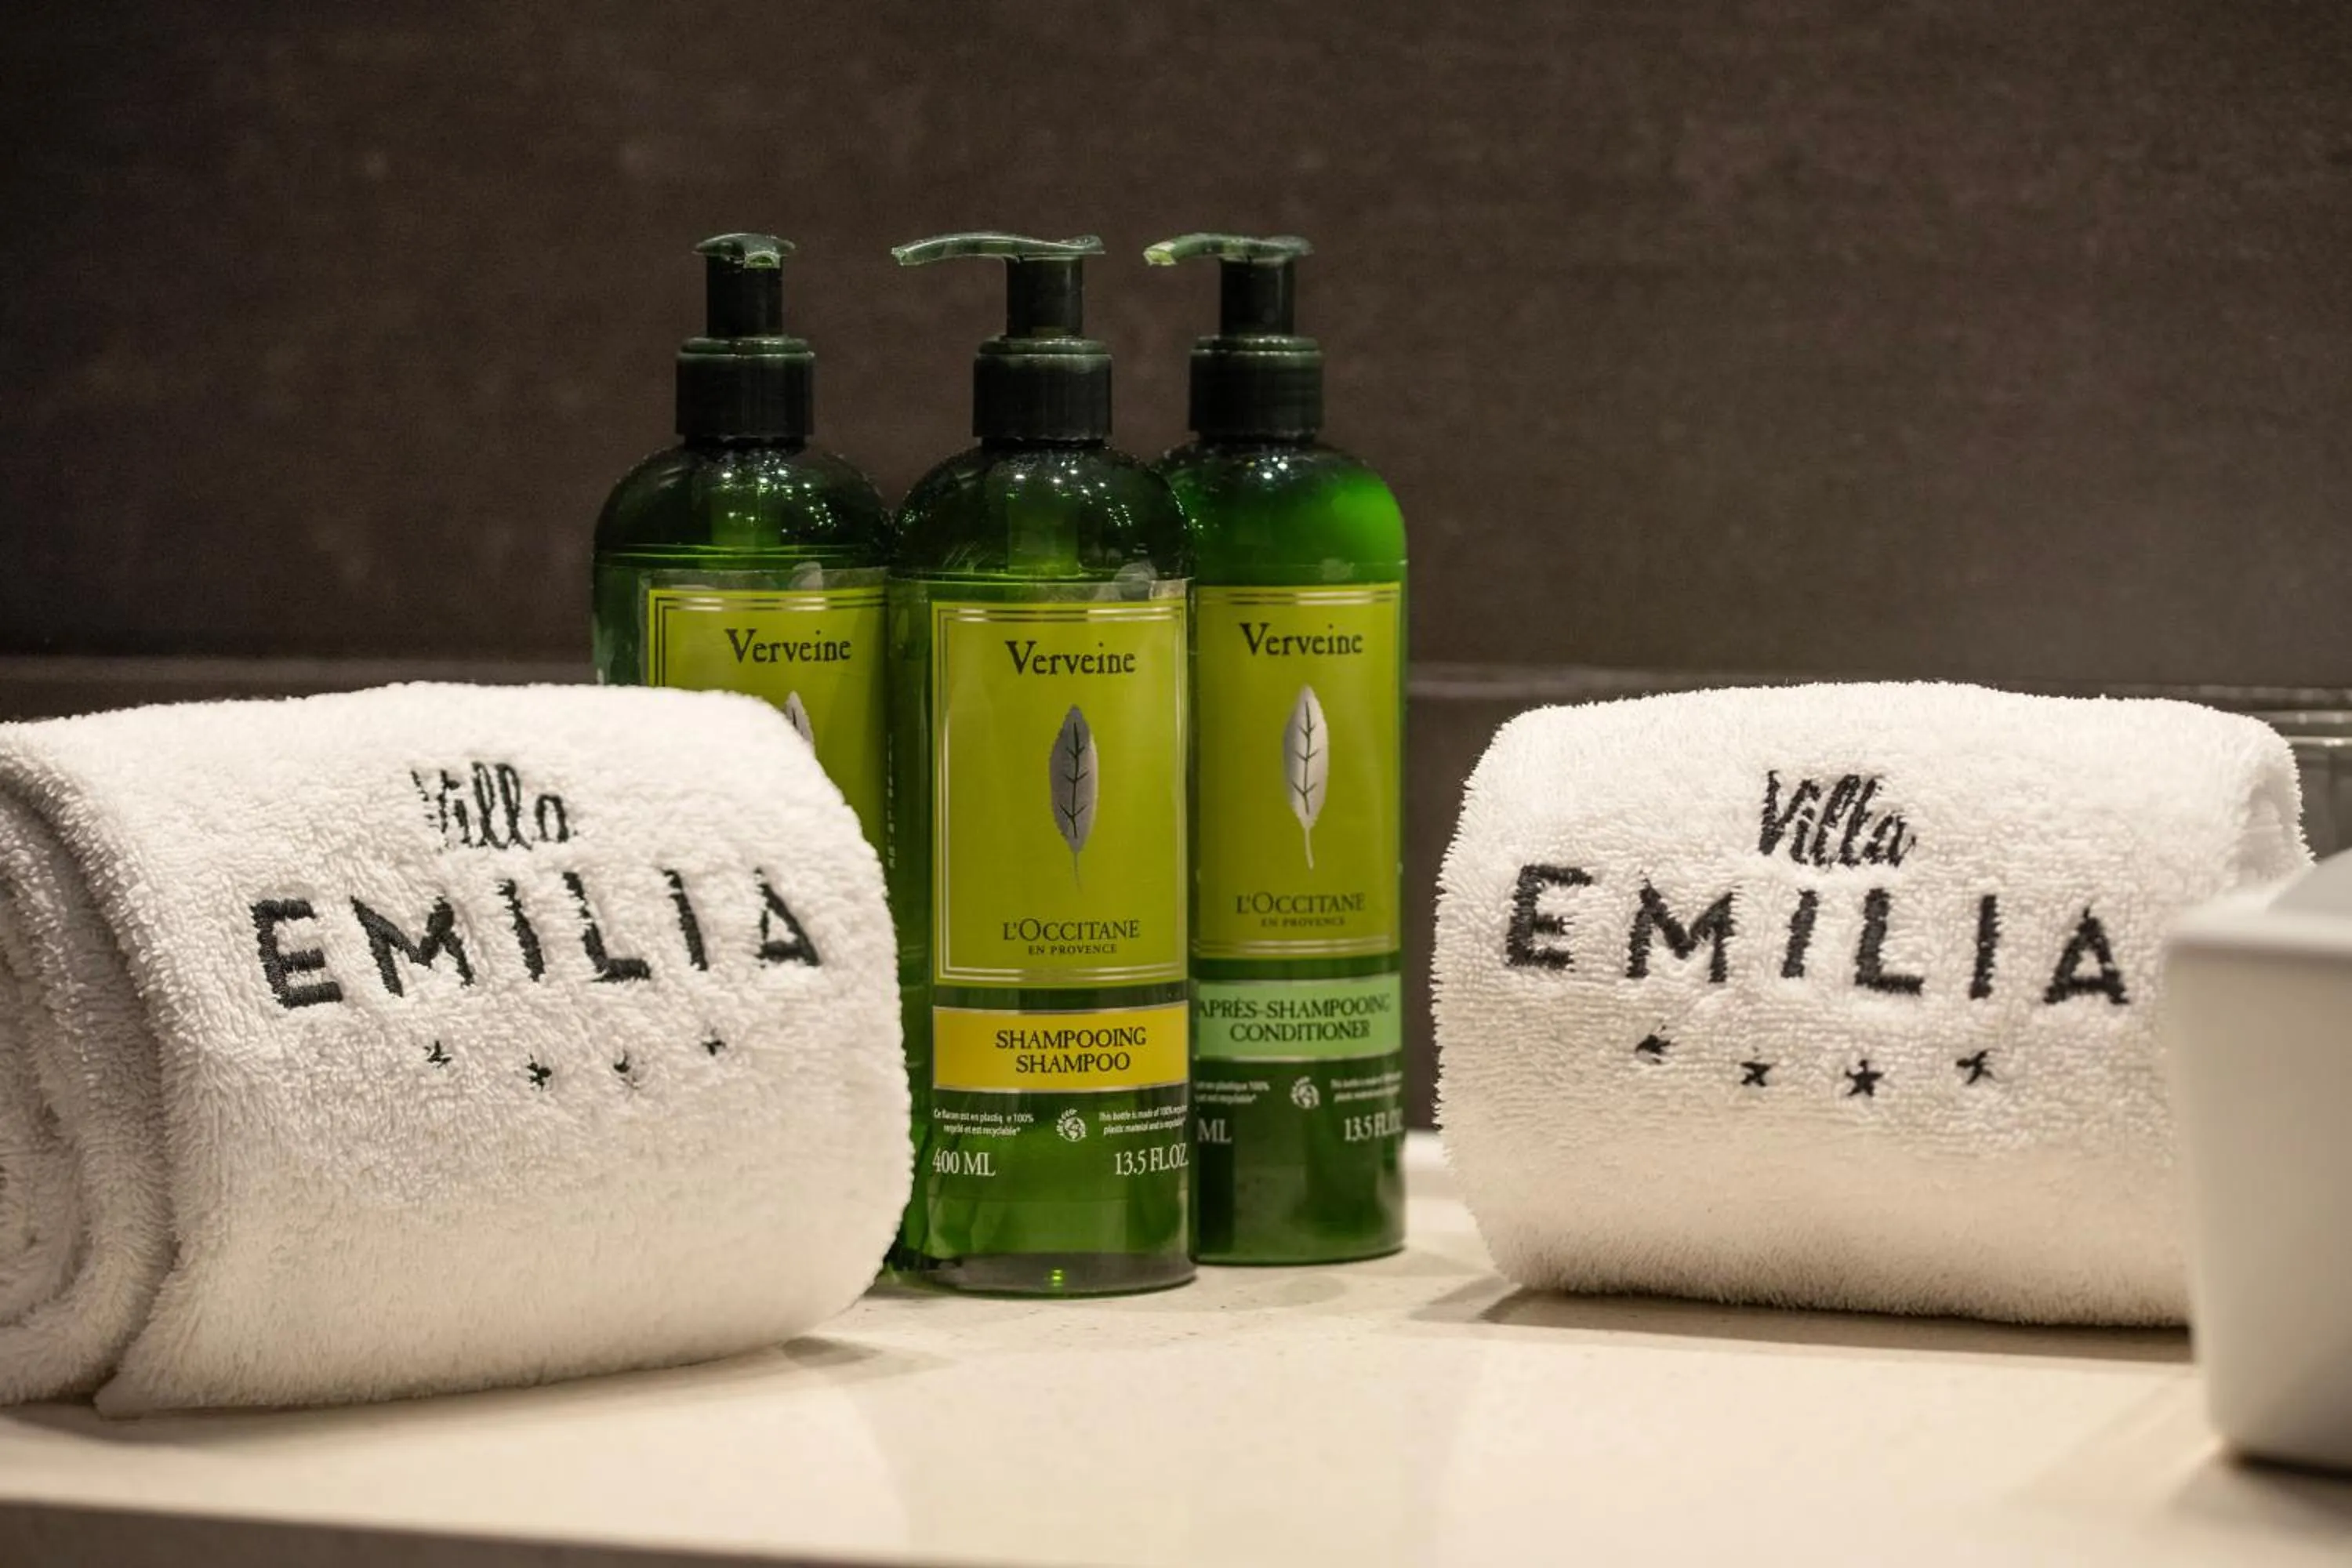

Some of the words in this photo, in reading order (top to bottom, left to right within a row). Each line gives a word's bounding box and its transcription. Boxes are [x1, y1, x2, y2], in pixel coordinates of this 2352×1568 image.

[724, 628, 852, 664] Verveine
[1239, 622, 1363, 656] Verveine
[1004, 640, 1136, 675] Verveine
[410, 760, 578, 850] Villa
[1758, 770, 1916, 869] Villa
[1003, 917, 1141, 942] L'OCCITANE
[1282, 916, 1346, 927] PROVENCE
[1505, 863, 2131, 1006] EMILIA
[250, 866, 822, 1008] EMILIA
[1028, 945, 1045, 956] EN
[1050, 942, 1118, 955] PROVENCE
[995, 1025, 1147, 1050] SHAMPOOING
[1229, 1019, 1371, 1043] CONDITIONER
[1015, 1051, 1131, 1074] SHAMPOO
[1013, 1113, 1034, 1123] 100%
[1198, 1118, 1232, 1144] ML
[932, 1147, 960, 1174] 400
[963, 1150, 997, 1177] ML
[1114, 1149, 1146, 1176] 13.5
